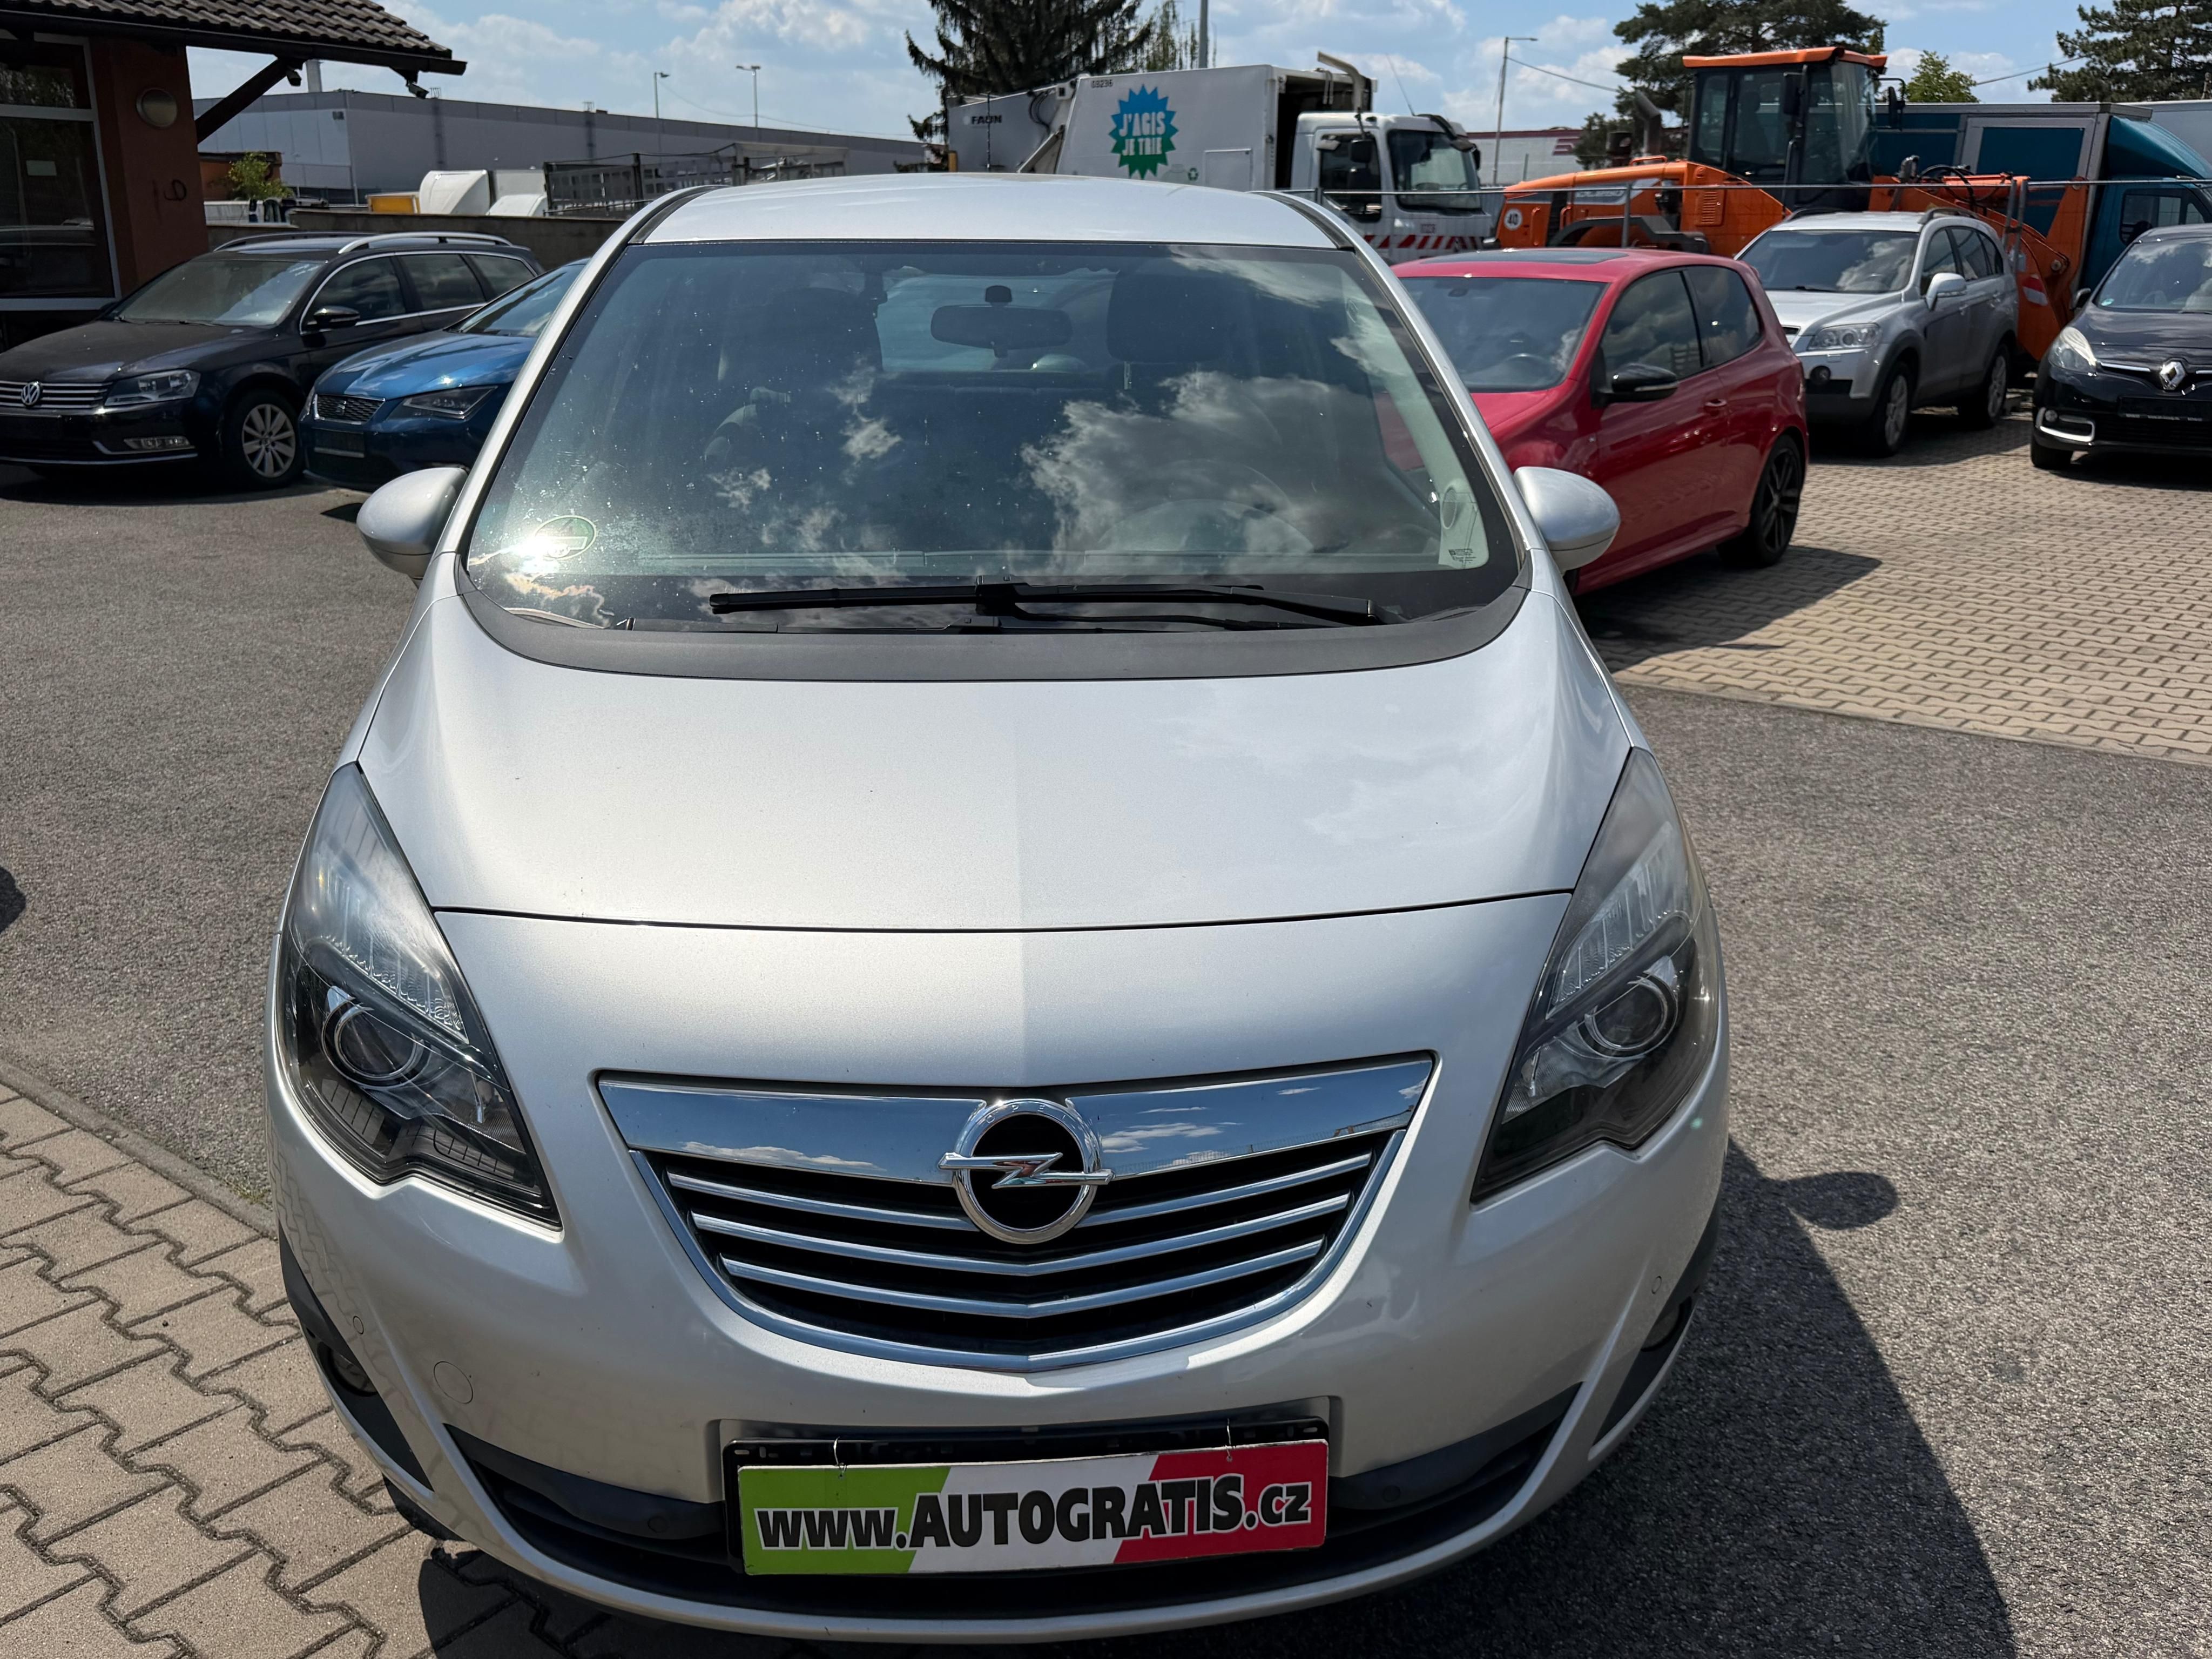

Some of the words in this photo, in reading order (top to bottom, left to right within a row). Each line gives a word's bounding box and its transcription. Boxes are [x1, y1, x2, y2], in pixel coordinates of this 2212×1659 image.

[971, 114, 1002, 125] FAUN
[1122, 139, 1135, 156] JE
[1138, 137, 1162, 155] TRIE
[1507, 213, 1519, 226] 40
